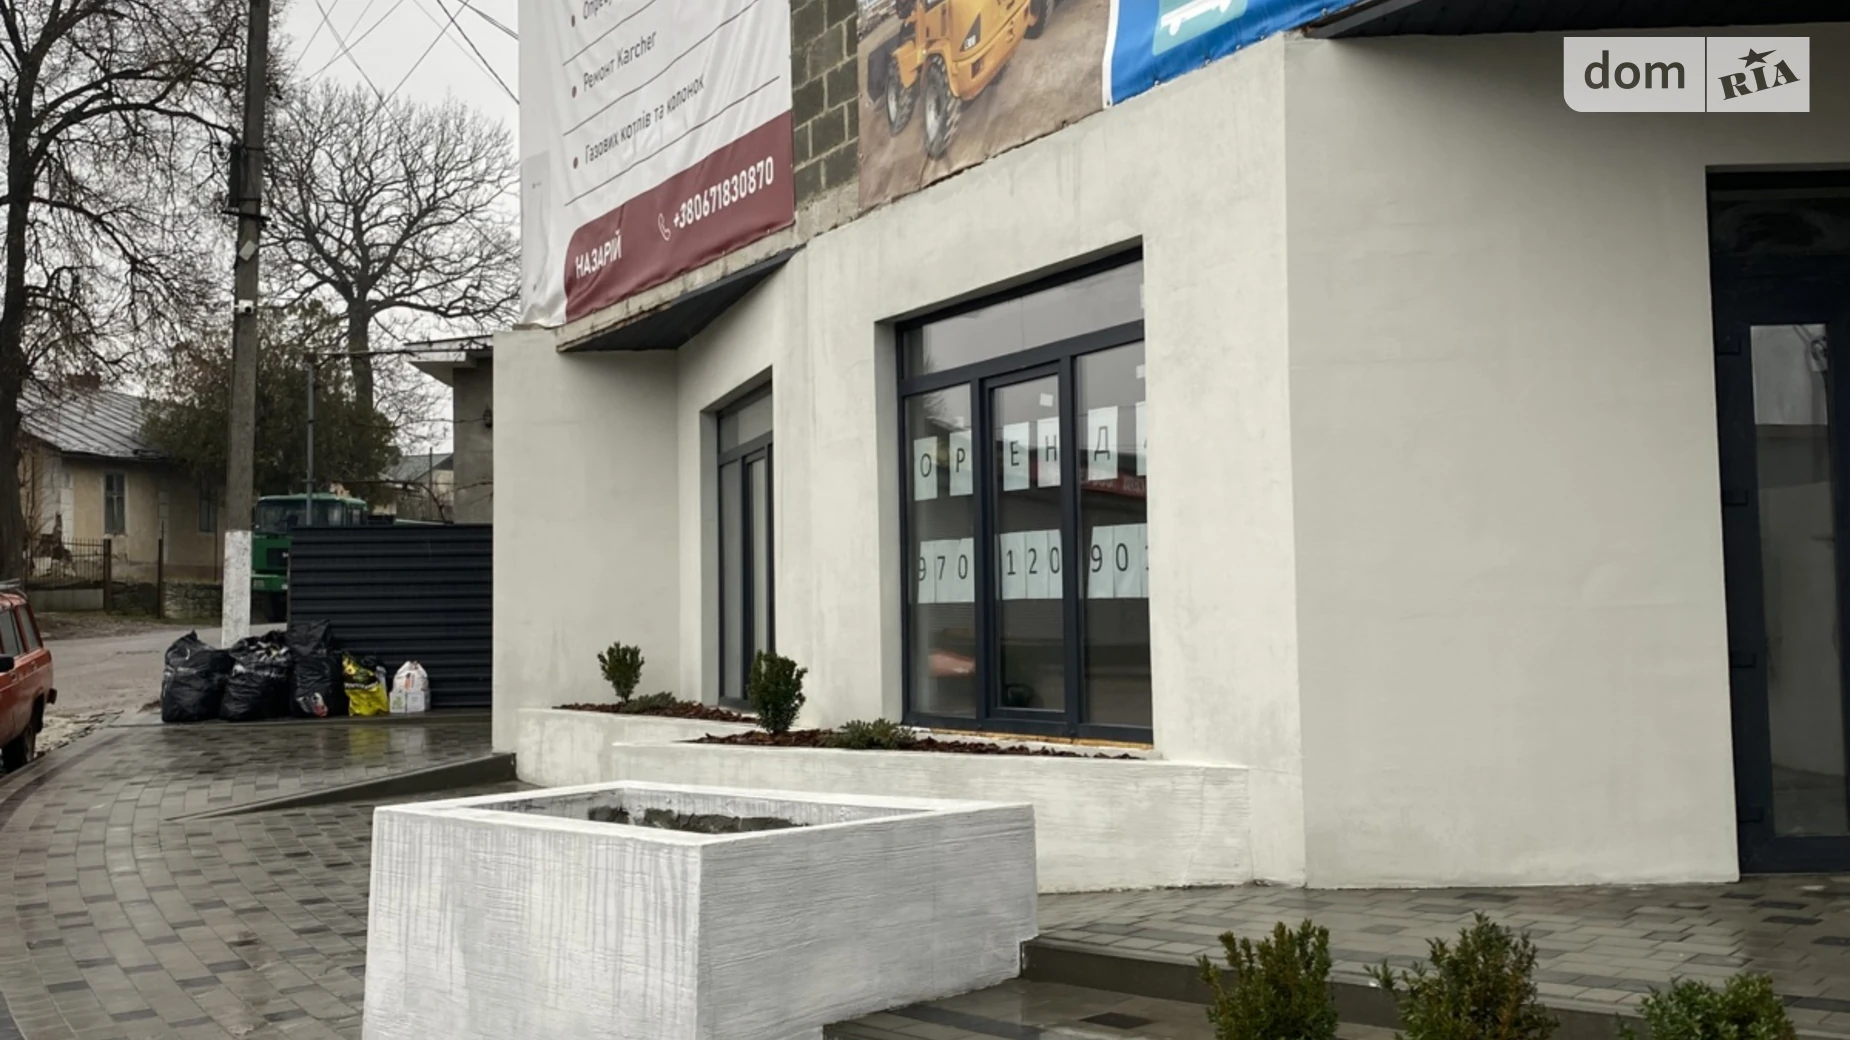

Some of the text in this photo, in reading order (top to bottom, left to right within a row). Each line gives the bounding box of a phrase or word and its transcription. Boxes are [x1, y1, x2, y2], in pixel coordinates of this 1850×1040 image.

[583, 31, 656, 92] Ремонт Karcher
[585, 72, 704, 164] Газових котлів та колонок
[673, 156, 774, 228] +380671830870
[575, 229, 622, 279] НАЗАРІЙ
[920, 425, 1147, 478] ОРЕНД
[1007, 547, 1060, 575] 120
[1091, 543, 1148, 572] 90
